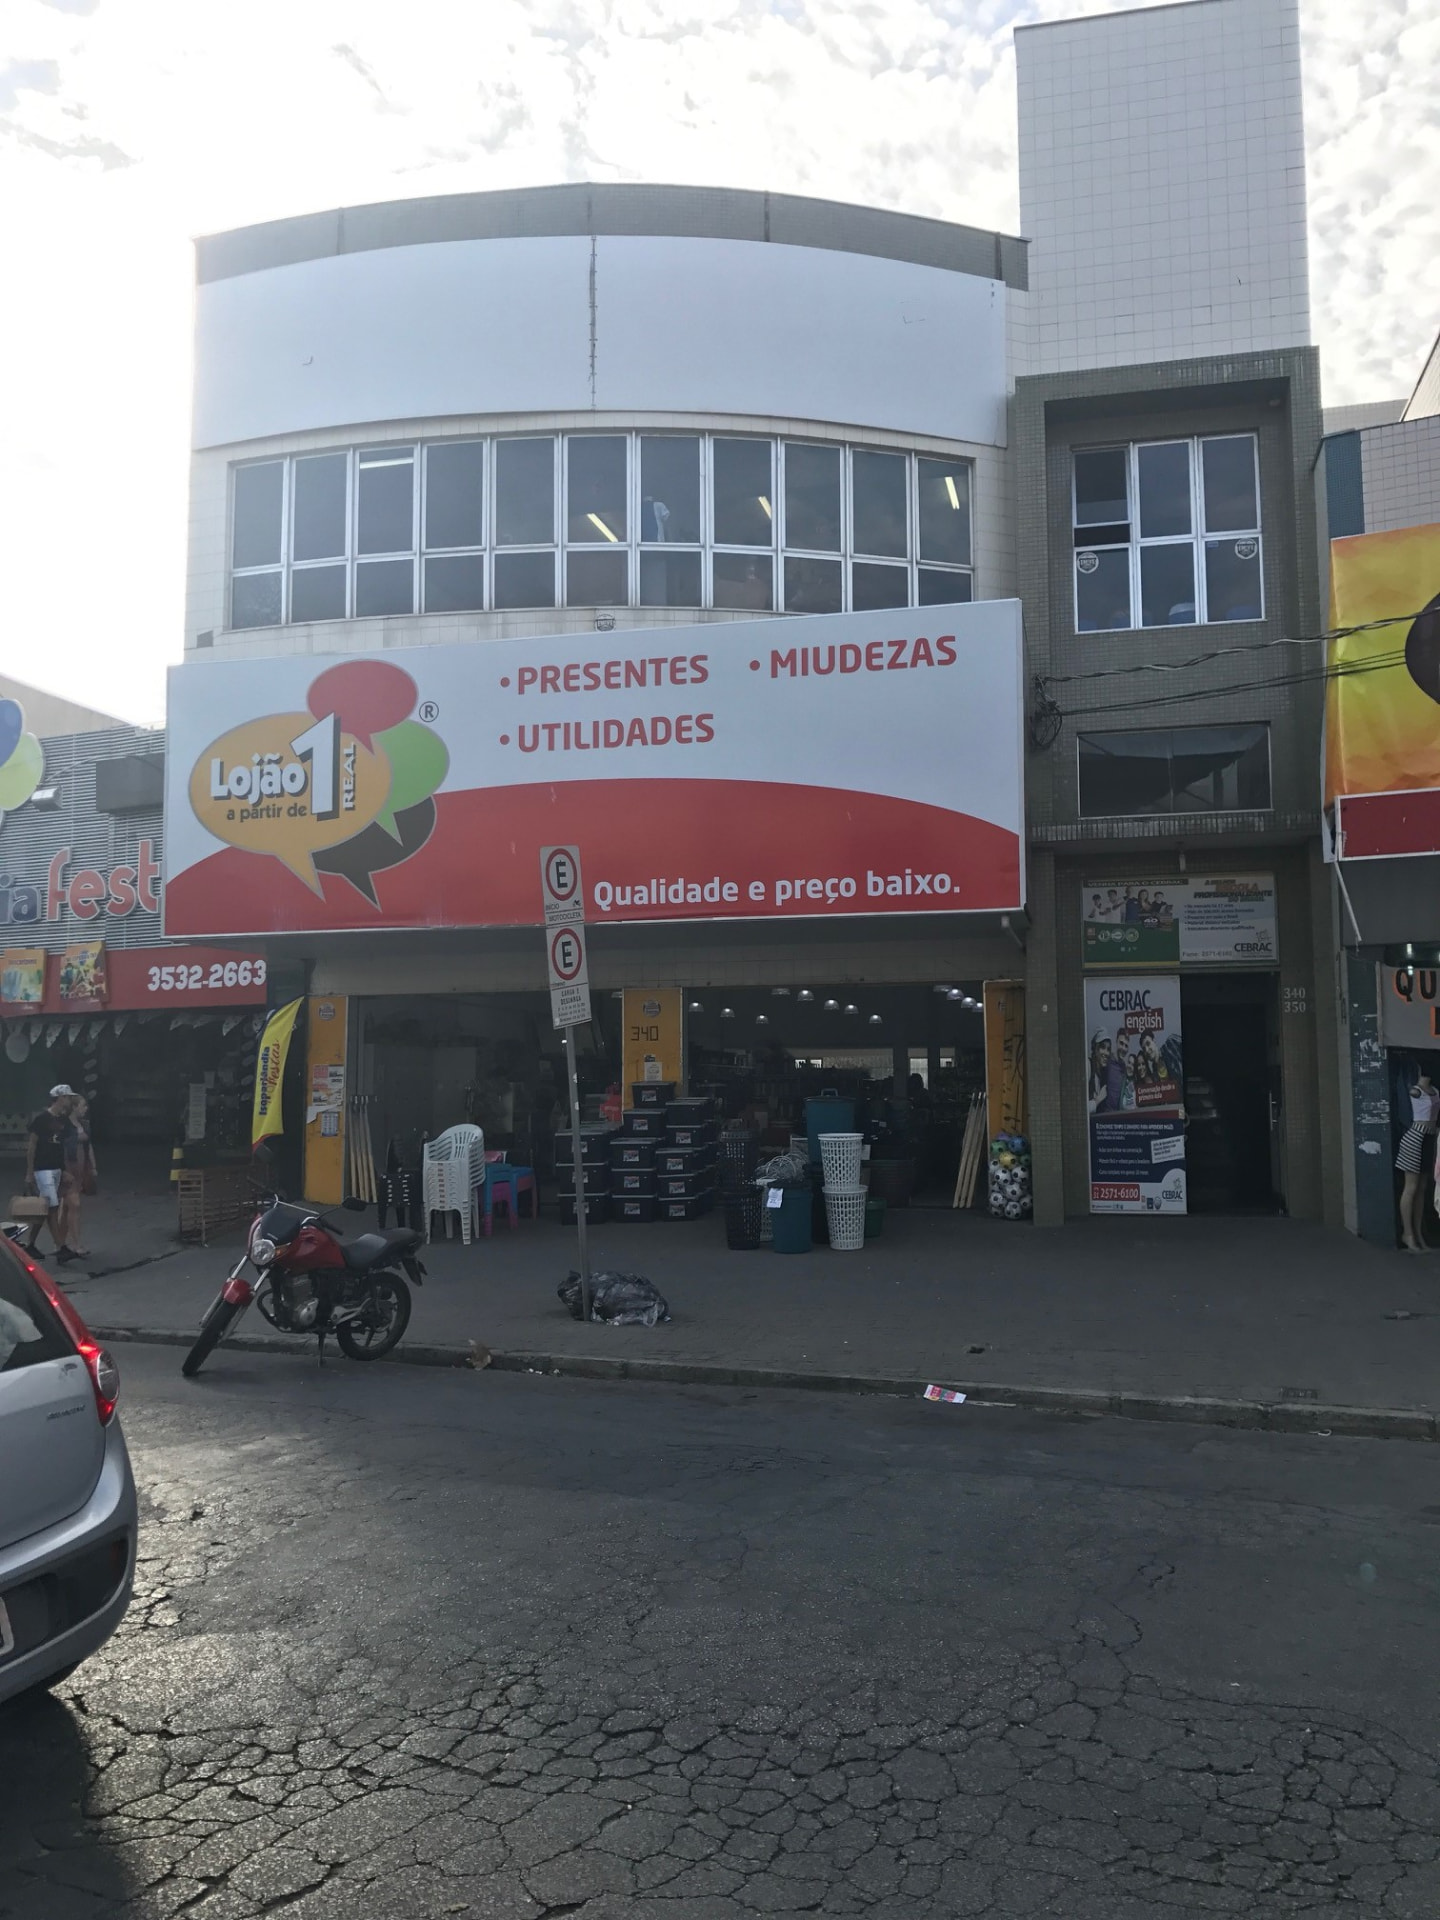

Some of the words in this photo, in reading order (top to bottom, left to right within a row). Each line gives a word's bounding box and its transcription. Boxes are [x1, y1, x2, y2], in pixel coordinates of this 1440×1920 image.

[771, 636, 957, 678] MIUDEZAS
[518, 655, 709, 695] PRESENTES
[518, 713, 715, 753] UTILIDADES
[210, 753, 308, 806] Lojão
[289, 712, 342, 821] 1
[343, 742, 357, 812] REAL
[227, 809, 235, 820] a
[240, 804, 283, 822] partir
[287, 803, 308, 818] de
[555, 861, 568, 889] E
[594, 876, 739, 911] Qualidade
[748, 883, 765, 902] e
[775, 878, 857, 906] preço
[866, 868, 961, 897] baixo.
[562, 941, 573, 969] E
[1234, 942, 1273, 952] CEBRAC
[147, 959, 267, 991] 3532-2663
[1099, 989, 1152, 1011] CEBRAC
[1283, 987, 1306, 999] 340
[1284, 1001, 1306, 1013] 350
[631, 1026, 659, 1041] 340
[1126, 1010, 1162, 1033] english
[1100, 1188, 1139, 1199] 2571-6100
